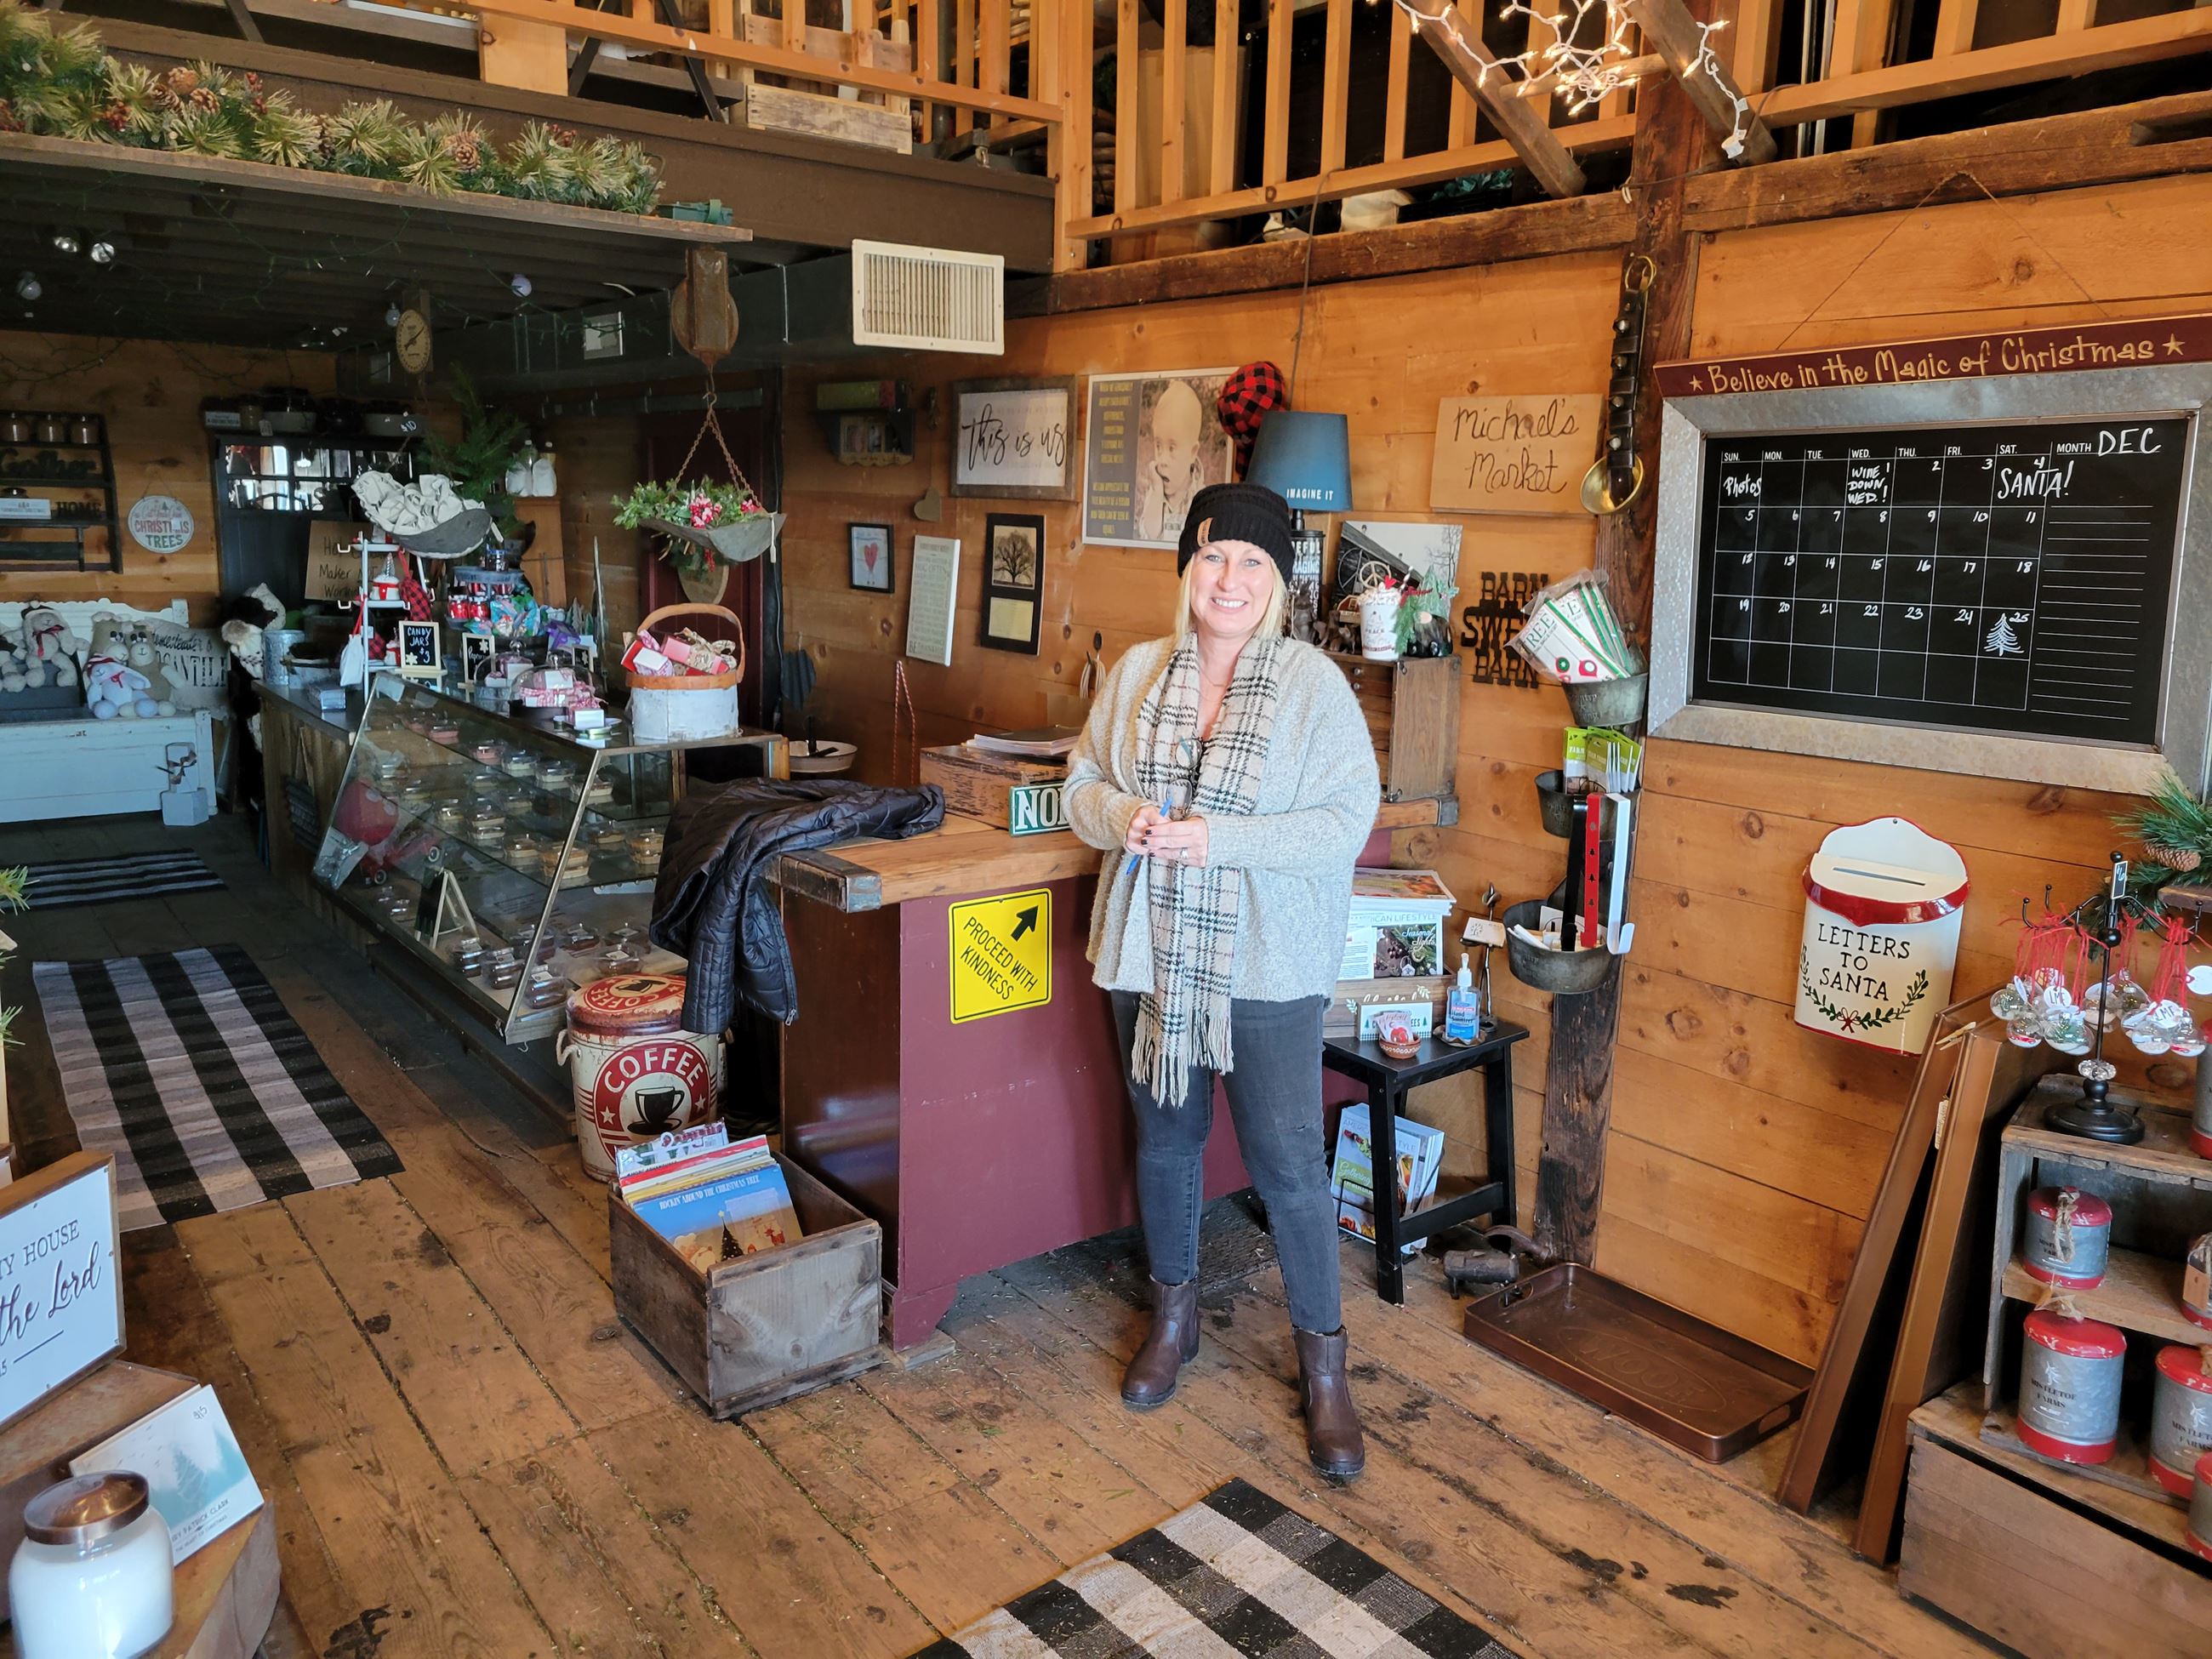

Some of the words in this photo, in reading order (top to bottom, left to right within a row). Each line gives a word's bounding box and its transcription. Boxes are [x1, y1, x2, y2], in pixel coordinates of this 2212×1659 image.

[1707, 365, 1793, 393] Believe
[1798, 363, 1819, 387] in
[1822, 354, 1868, 385] the
[1874, 349, 1950, 380] Magic
[1958, 340, 1991, 375] of
[2002, 335, 2155, 372] Christmas
[1454, 398, 1579, 442] Michael's
[961, 403, 1009, 470] this
[1016, 431, 1035, 457] is
[1041, 423, 1065, 467] us
[2056, 442, 2091, 453] MONTH
[2098, 427, 2161, 457] DEC
[1725, 453, 1740, 461] SUN.
[1764, 451, 1783, 460] MON.
[1807, 450, 1823, 459] TUE.
[1851, 448, 1870, 459] WED.
[1899, 448, 1917, 457] THU.
[1947, 446, 1963, 455] FRI.
[1999, 444, 2017, 454] SAT.
[1931, 461, 1941, 470] 2
[1981, 459, 1993, 470] 3
[2033, 457, 2044, 468] 4
[1465, 448, 1567, 493] Market
[1851, 465, 1879, 478] WINE
[1723, 473, 1762, 497] Photos
[1847, 477, 1884, 490] DOWN
[1997, 460, 2074, 499] SANTA!
[1286, 488, 1321, 499] IMAGINE
[1325, 490, 1333, 501] IT
[1745, 510, 1755, 521] 5
[1792, 510, 1799, 521] 6
[1833, 510, 1840, 522] 7
[1879, 510, 1888, 522] 8
[1927, 510, 1936, 522] 9
[1972, 511, 1988, 522] 10
[2025, 511, 2036, 522] 11
[145, 534, 183, 548] TREES
[1742, 553, 1753, 564] 12
[1783, 555, 1795, 566] 13
[1825, 557, 1836, 569] 14
[1871, 558, 1884, 570] 15
[319, 563, 351, 579] Maker
[1916, 560, 1931, 572] 16
[1963, 561, 1976, 573] 17
[2016, 561, 2032, 573] 18
[1739, 599, 1749, 612] 19
[1778, 601, 1790, 613] 20
[1819, 602, 1833, 614] 21
[1863, 605, 1878, 617] 22
[1904, 607, 1924, 620] 23
[1953, 608, 1974, 625] 24
[2009, 612, 2030, 623] 25
[408, 626, 431, 638] CANDY
[409, 637, 429, 647] JARS
[1818, 923, 1910, 959] LETTERS
[963, 916, 1013, 968] PROCEED
[1011, 961, 1039, 992] WITH
[1840, 952, 1868, 971] TO
[961, 945, 1014, 1001] KINDNESS
[1820, 968, 1889, 1001] SANTA
[590, 987, 659, 1007] COFFEE
[604, 1047, 704, 1093] COFFEE
[681, 1191, 704, 1203] AROUND
[704, 1189, 714, 1197] THE
[715, 1180, 745, 1194] CHRISTMAS
[746, 1175, 760, 1185] TREE
[23, 1219, 79, 1266] HOUSE
[48, 1240, 101, 1318] Lord
